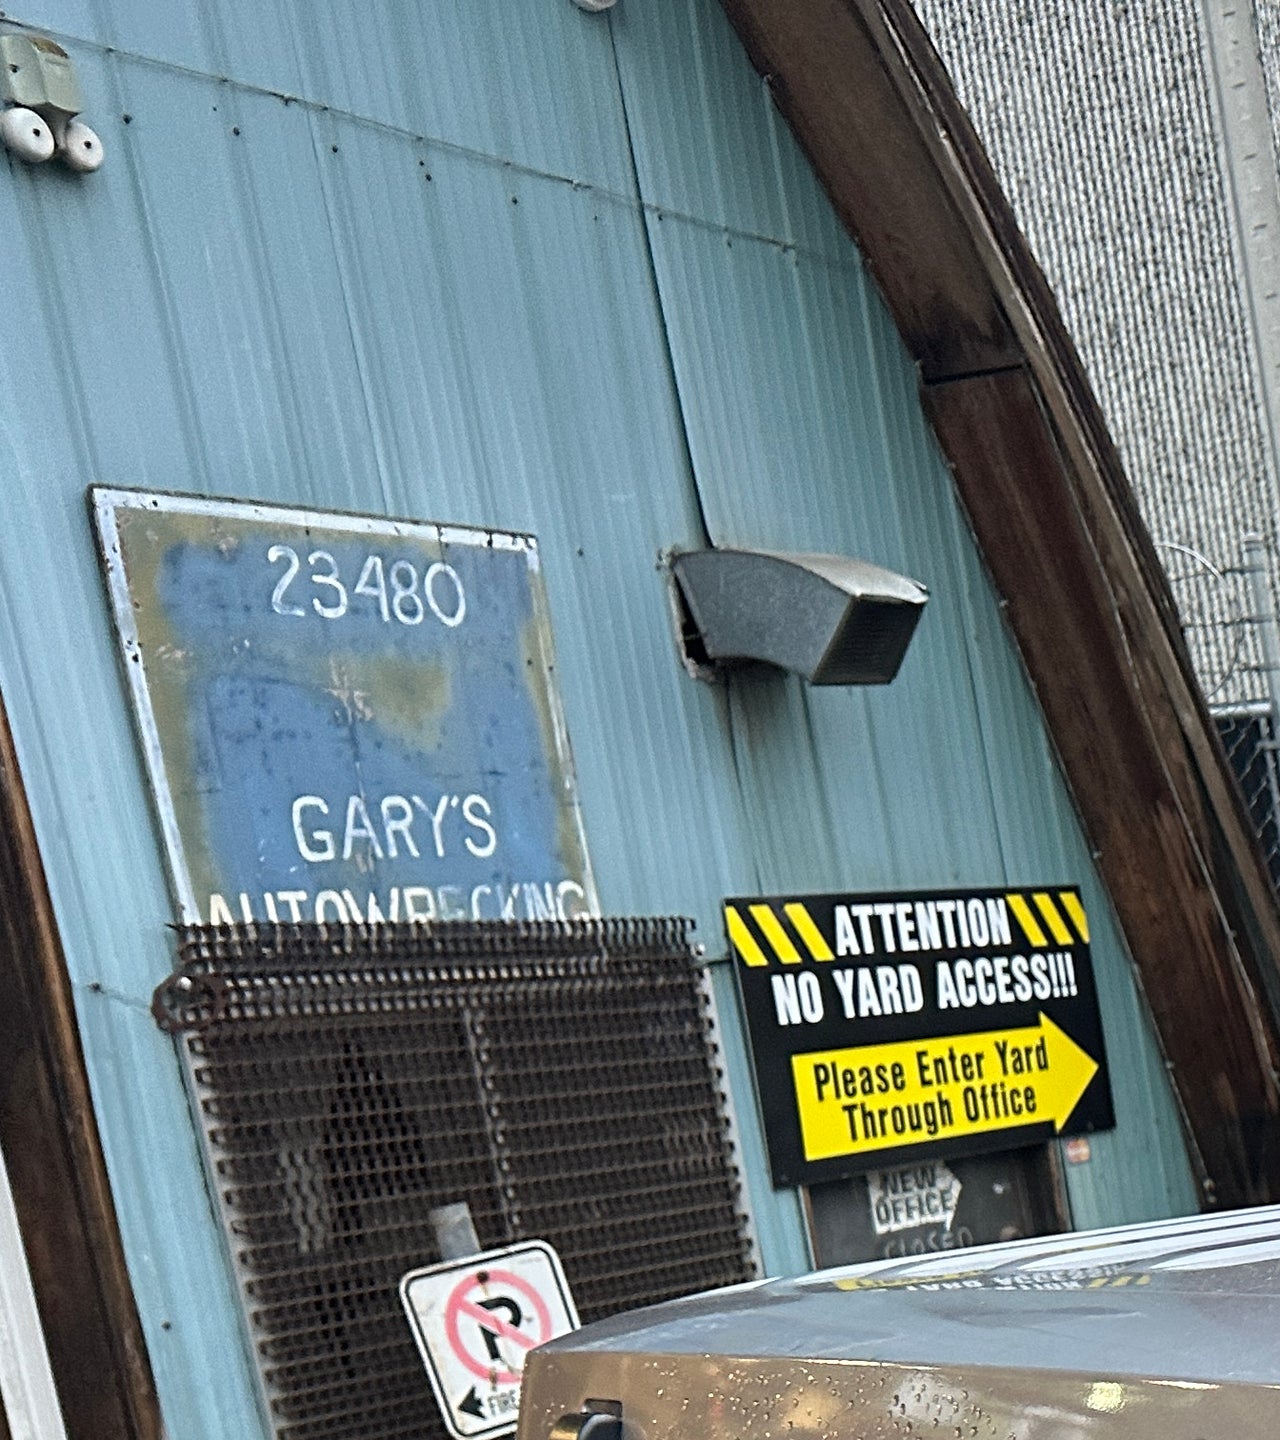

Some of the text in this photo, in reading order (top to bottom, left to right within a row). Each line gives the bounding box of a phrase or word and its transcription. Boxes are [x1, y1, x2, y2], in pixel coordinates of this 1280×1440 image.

[268, 545, 467, 627] 23480
[291, 794, 497, 863] GARY'S
[833, 898, 1012, 957] ATTENTION
[771, 951, 1078, 1026] NO YARD ACCESS!!!
[813, 1035, 1050, 1102] Please Enter Yard
[842, 1081, 1037, 1142] Through Office
[875, 1187, 953, 1225] OFFICE
[879, 1166, 938, 1195] NEW
